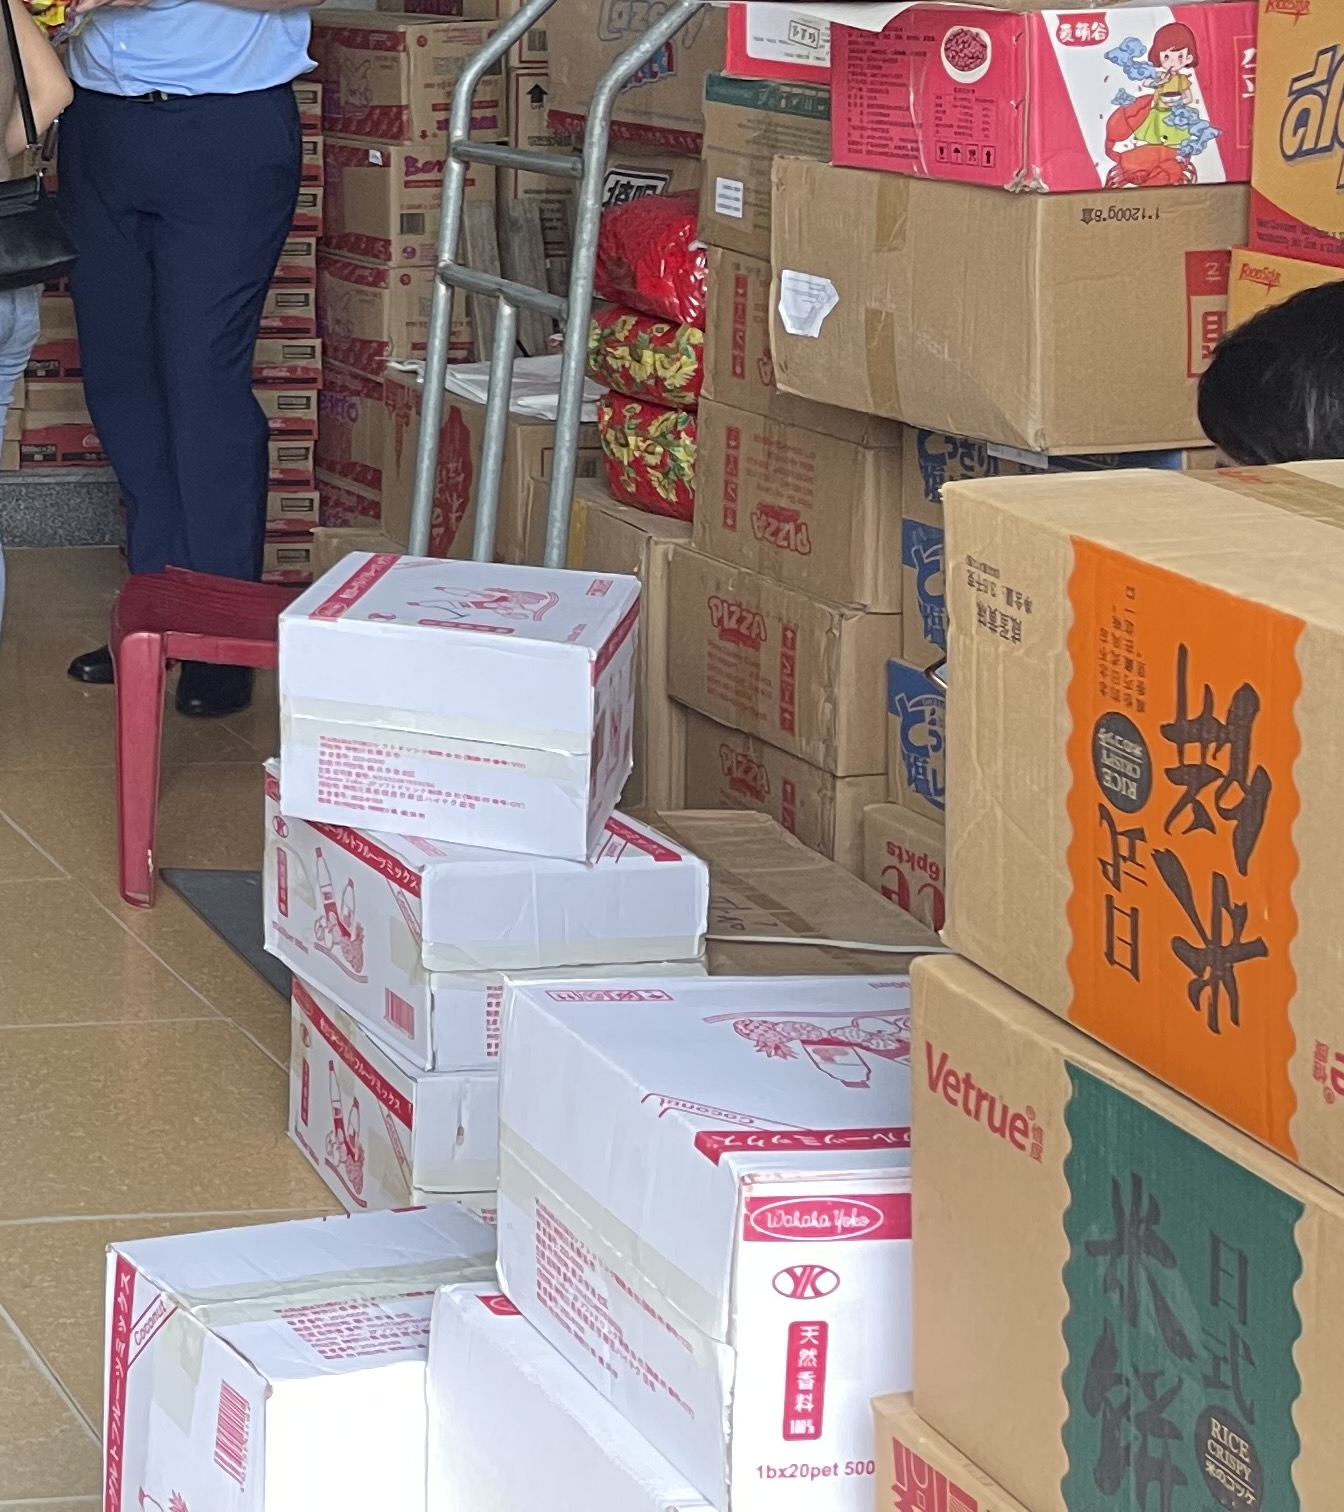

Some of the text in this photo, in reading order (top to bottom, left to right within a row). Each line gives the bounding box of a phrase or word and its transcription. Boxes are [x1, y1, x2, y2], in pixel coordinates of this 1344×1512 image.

[708, 595, 769, 643] PIZZA
[718, 744, 771, 795] PIZZA
[1102, 768, 1139, 801] RICE
[924, 1040, 1030, 1151] Vetrue
[765, 1210, 831, 1230] Wahaha
[1206, 1438, 1254, 1483] CRISPY
[1209, 1417, 1251, 1464] RICE
[755, 1459, 876, 1482] 1bx20pet 500
